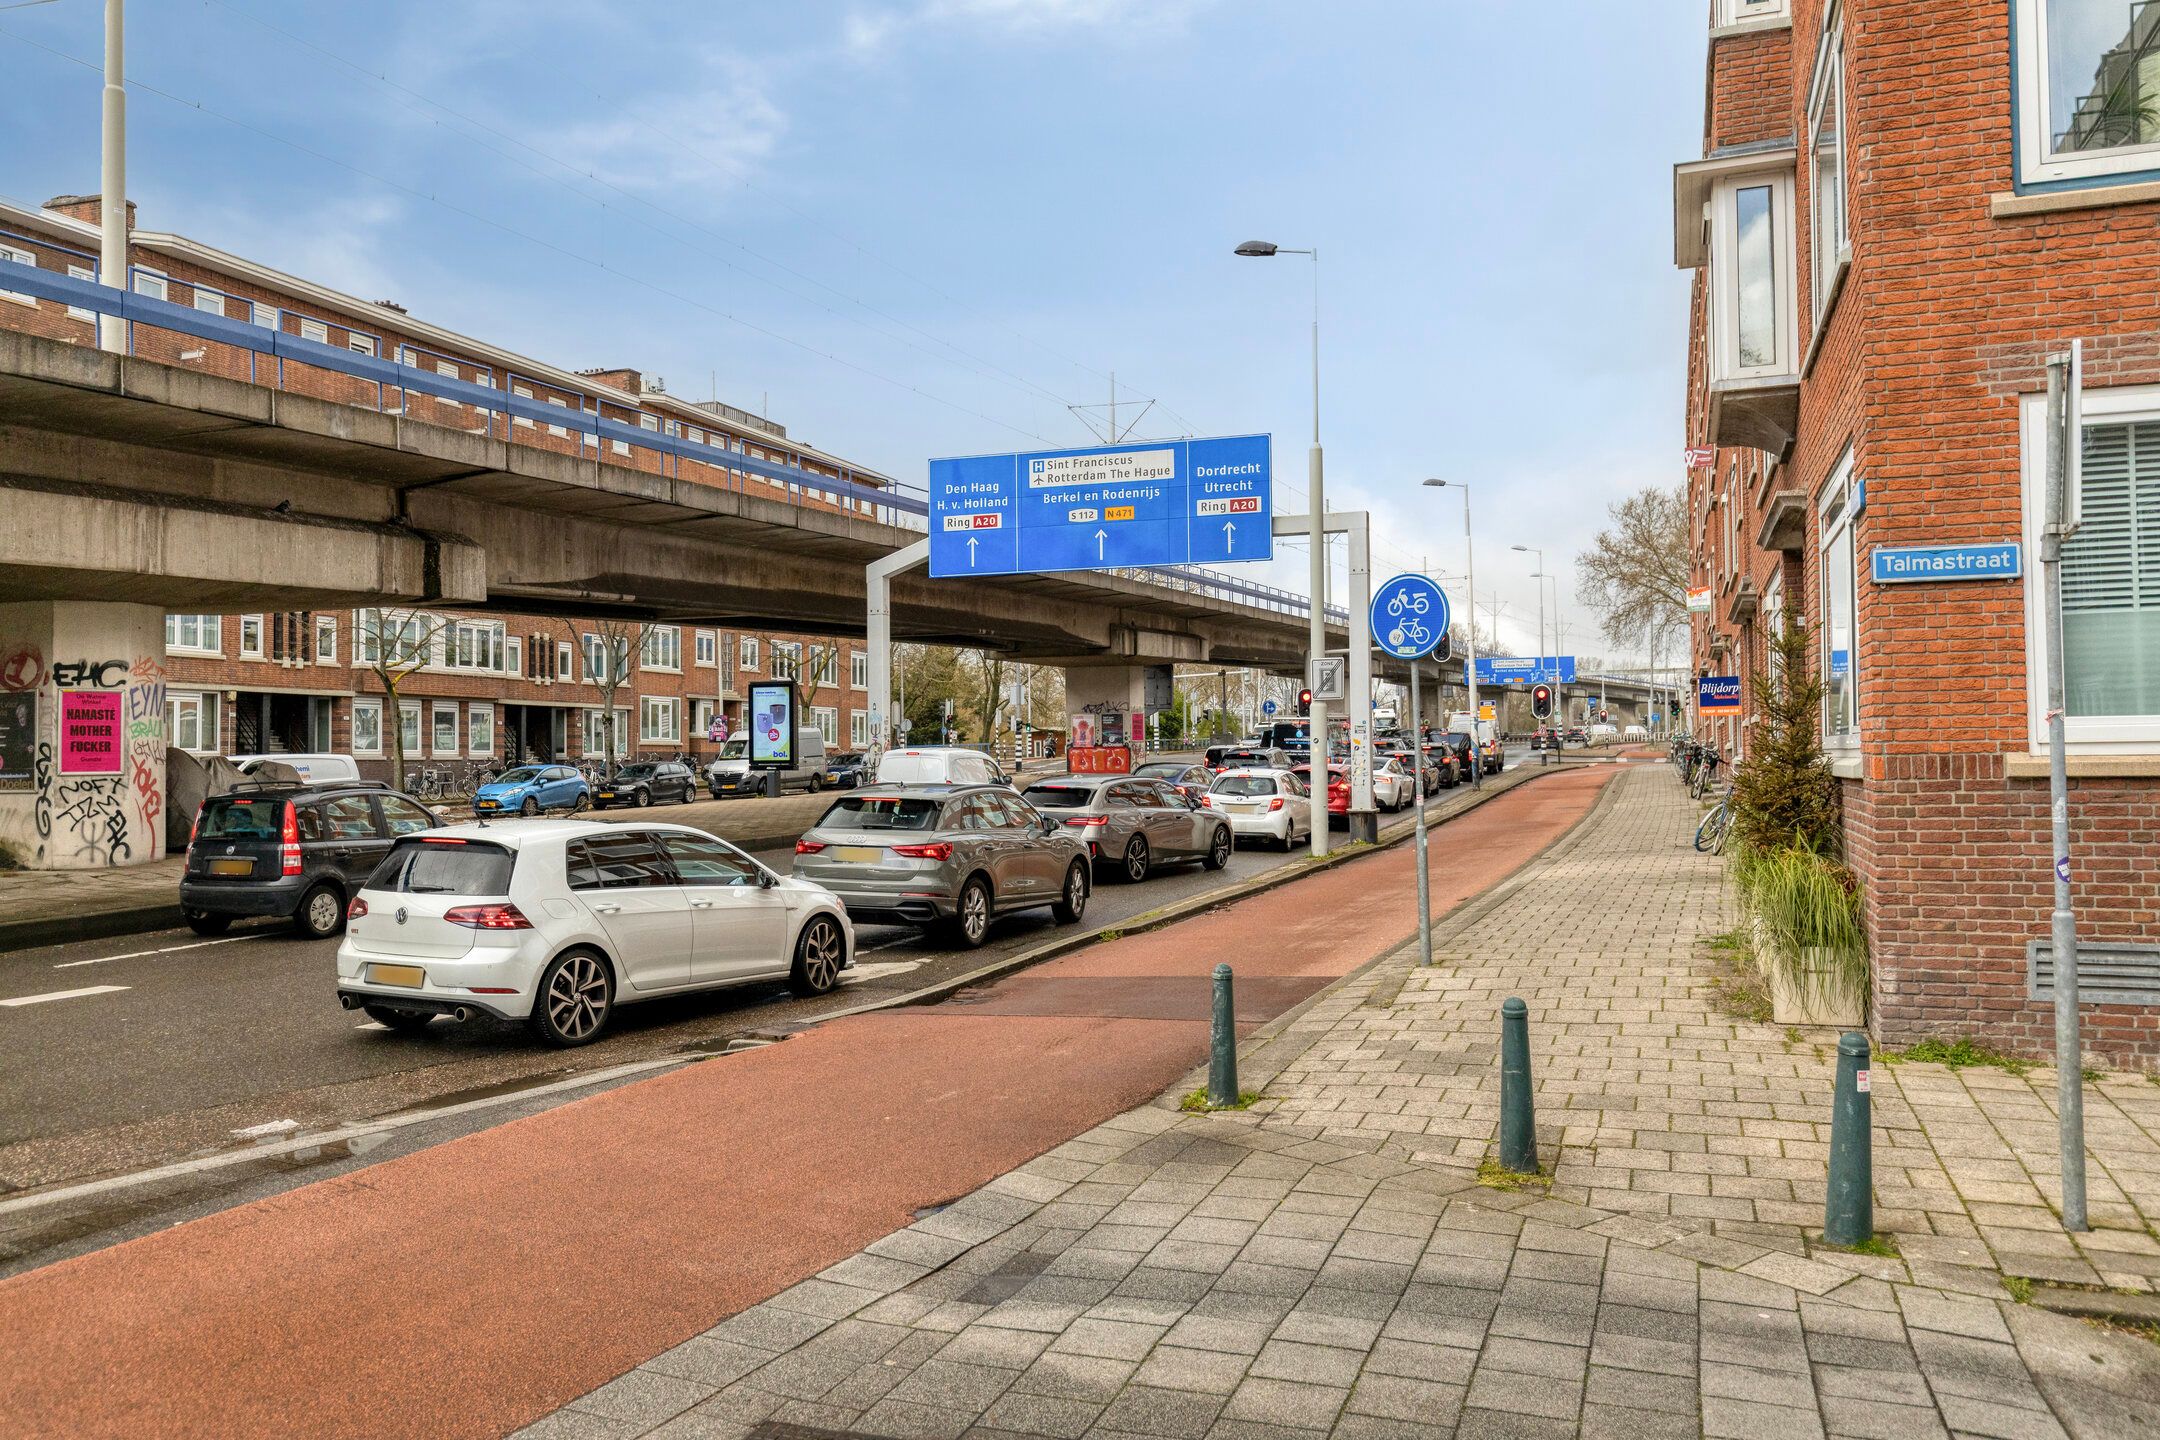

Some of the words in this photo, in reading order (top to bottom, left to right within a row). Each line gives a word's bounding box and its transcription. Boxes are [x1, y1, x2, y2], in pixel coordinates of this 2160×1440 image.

[1047, 460, 1069, 470] Sint
[1073, 456, 1133, 468] Franciscus
[1047, 471, 1106, 483] Rotterdam
[1110, 469, 1130, 479] The
[1134, 467, 1170, 479] Hague
[1197, 463, 1261, 477] Dordrecht
[945, 484, 967, 494] Den
[971, 482, 999, 493] Haag
[1205, 480, 1253, 493] Utrecht
[1043, 491, 1080, 504] Berkel
[1085, 492, 1098, 501] en
[1103, 486, 1160, 500] Rodenrijs
[937, 500, 949, 510] H.
[952, 501, 961, 510] v.
[964, 496, 1008, 509] Holland
[1201, 502, 1227, 513] Ring
[1232, 500, 1255, 510] A20
[947, 518, 970, 528] Ring
[975, 517, 996, 526] A20
[1882, 550, 2010, 573] Talmastraat
[1700, 682, 1739, 696] Blijdorp
[66, 706, 116, 721] NAMASTÉ
[70, 725, 112, 737] MOTHER
[70, 741, 111, 753] FUCKER
[773, 750, 788, 758] bol.
[2, 779, 34, 790] Doelen
